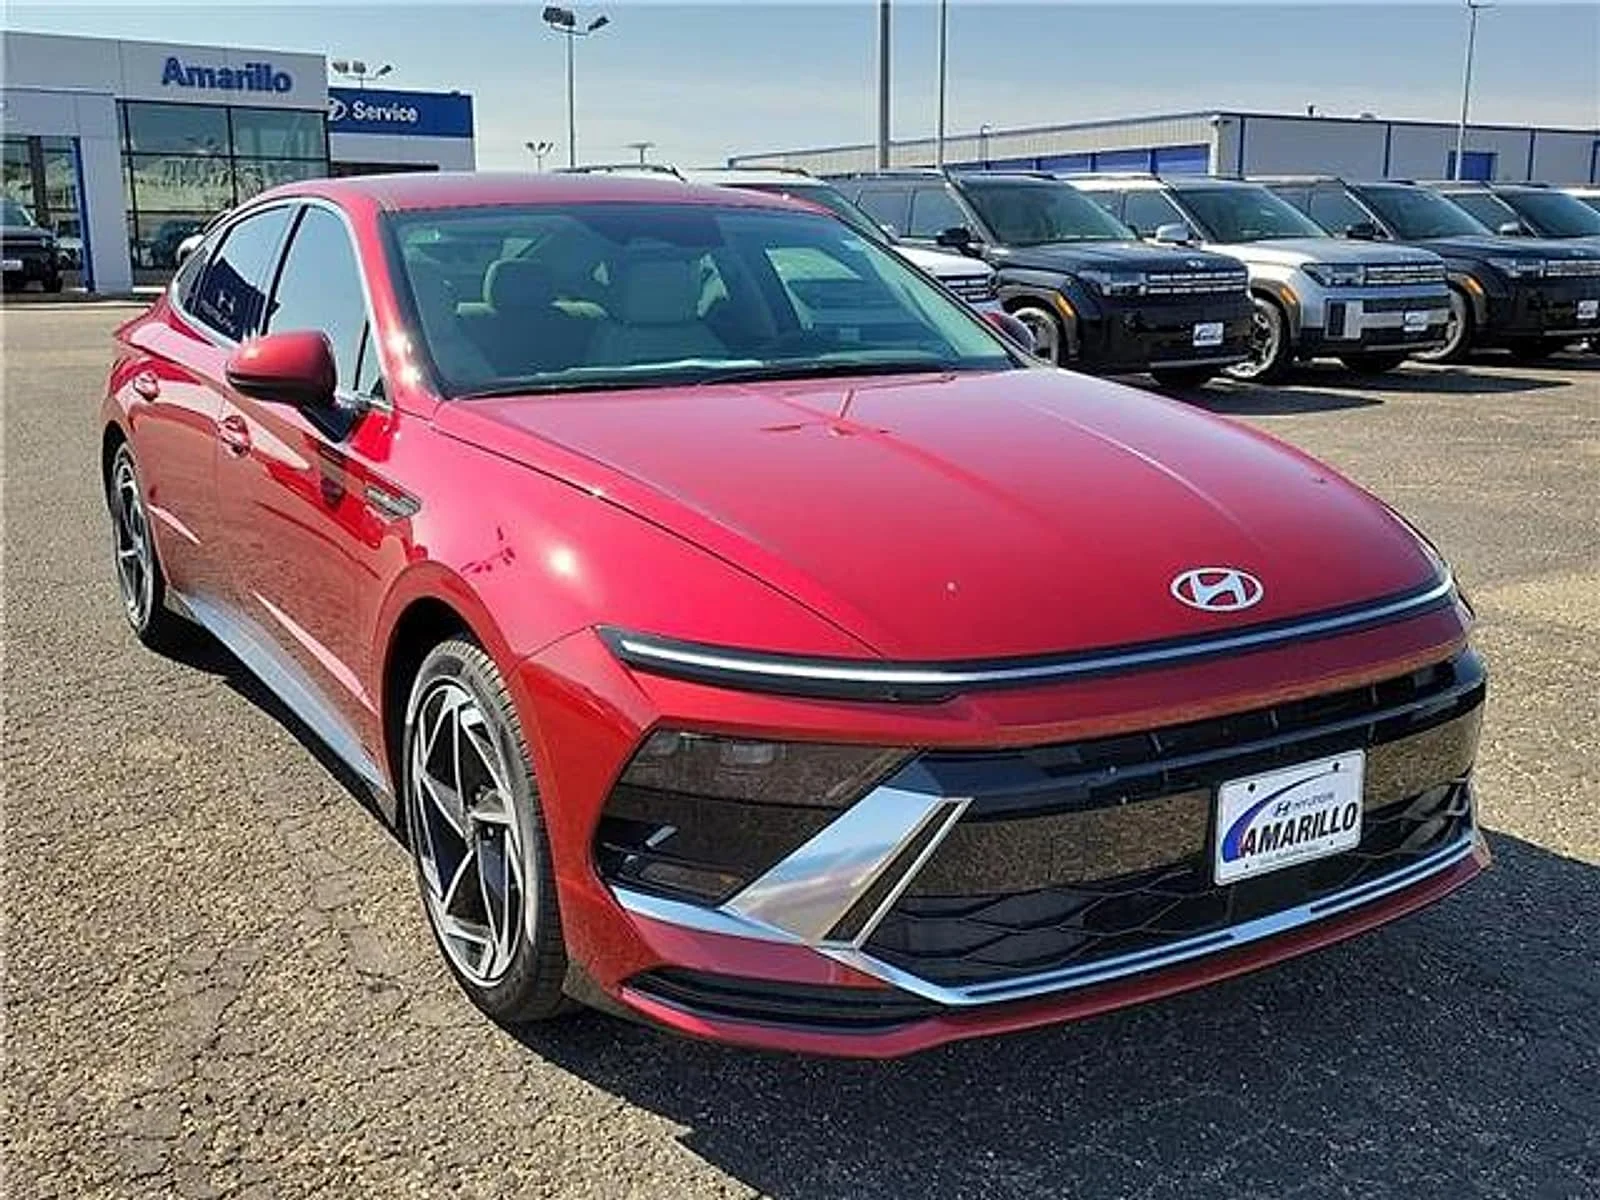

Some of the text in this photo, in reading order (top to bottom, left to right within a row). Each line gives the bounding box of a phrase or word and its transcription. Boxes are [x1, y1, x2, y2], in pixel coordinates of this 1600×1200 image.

[162, 57, 292, 92] Amarillo
[352, 100, 419, 122] Service
[1240, 802, 1358, 857] AMARILLO
